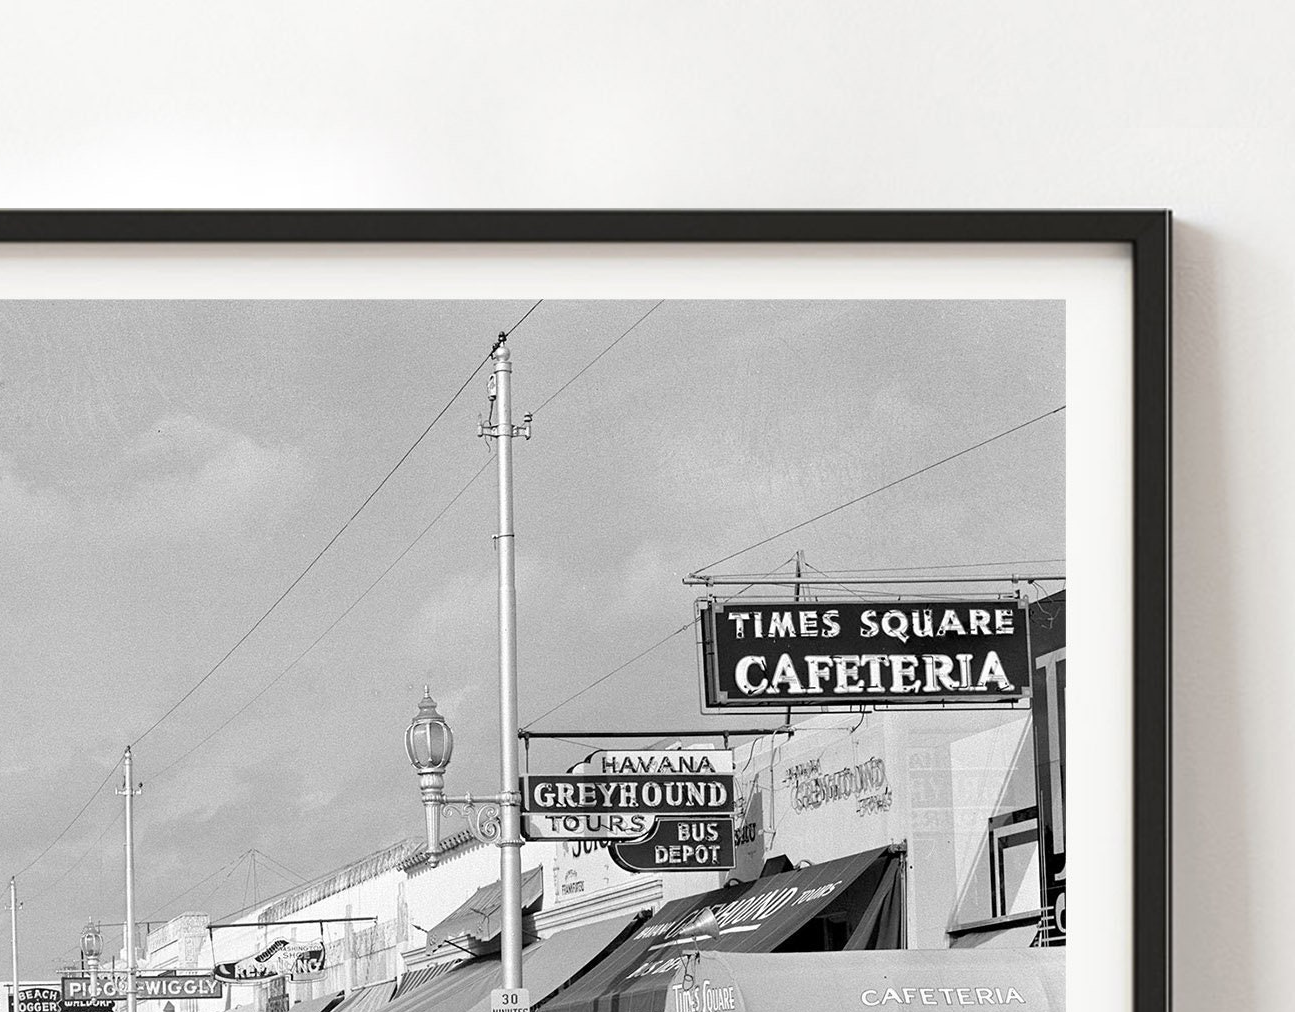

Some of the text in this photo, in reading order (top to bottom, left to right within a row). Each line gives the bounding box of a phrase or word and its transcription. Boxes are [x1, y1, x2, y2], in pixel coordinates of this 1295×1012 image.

[728, 608, 1015, 643] TIMES SQUARE
[734, 650, 1016, 695] CAFETERIA
[602, 755, 716, 774] HAVANA
[533, 781, 728, 808] GREYHOUND
[545, 814, 646, 833] TOURS
[677, 822, 719, 842] BUS
[654, 845, 721, 865] DEPOT
[18, 989, 58, 1001] BEACH
[502, 993, 518, 1005] 30
[861, 987, 1027, 1006] CAFETERIA
[11, 1002, 58, 1012] OGGER
